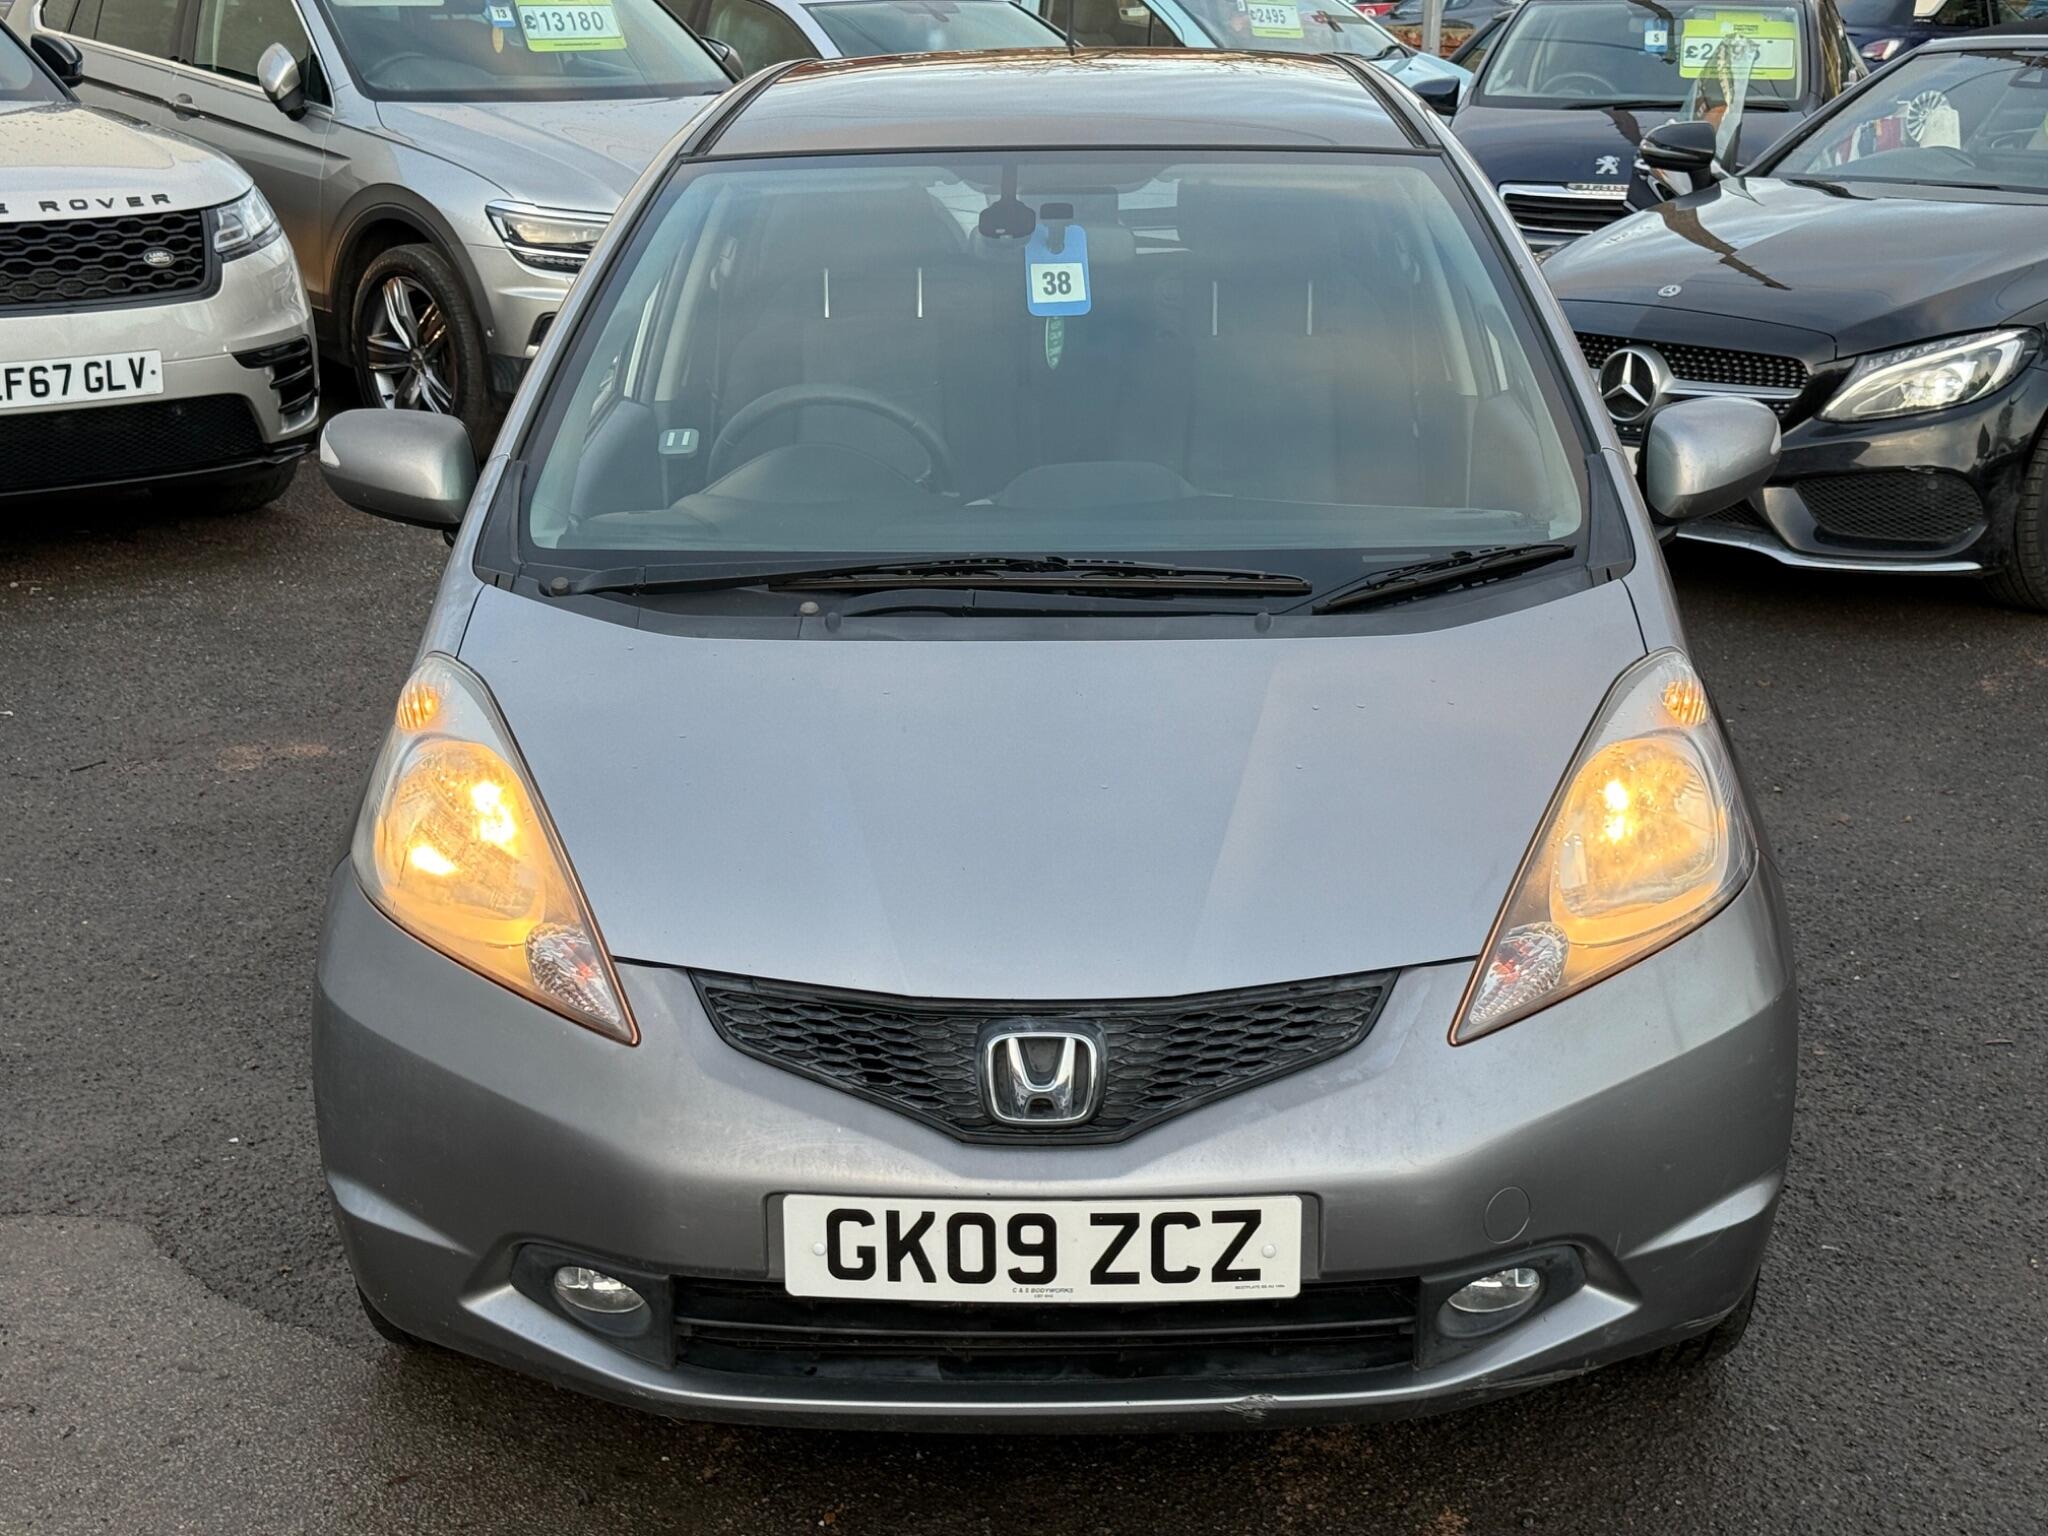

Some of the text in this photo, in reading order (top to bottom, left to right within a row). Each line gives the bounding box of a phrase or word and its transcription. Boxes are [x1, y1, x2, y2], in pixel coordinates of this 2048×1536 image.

[496, 9, 507, 19] 13
[38, 193, 171, 212] ROVER
[1042, 271, 1072, 296] 38
[0, 356, 146, 401] F67 GLV
[826, 1208, 1262, 1285] GK09 ZCZ
